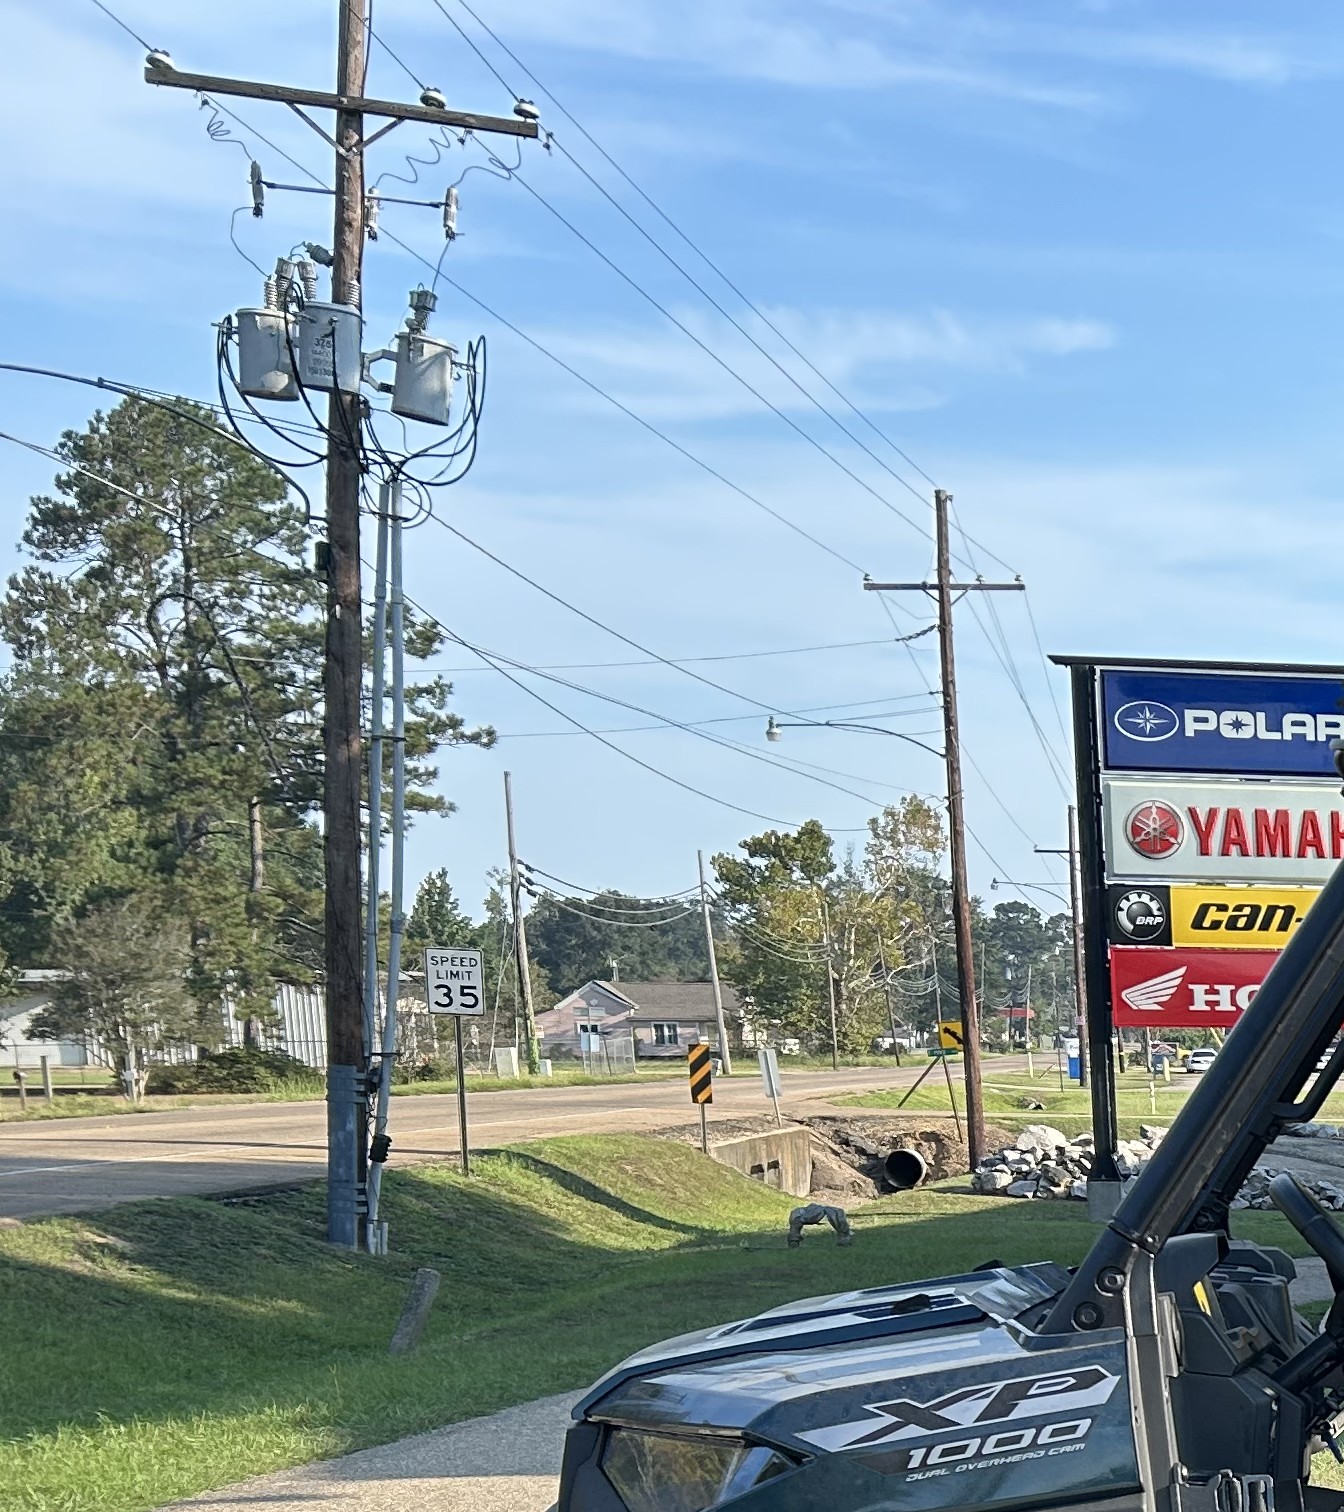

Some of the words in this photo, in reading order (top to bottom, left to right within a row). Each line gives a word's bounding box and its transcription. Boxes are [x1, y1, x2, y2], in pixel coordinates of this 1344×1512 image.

[1136, 916, 1163, 926] BRP
[1190, 903, 1304, 932] can-
[430, 955, 478, 967] SPEED
[436, 969, 472, 980] LIMIT
[434, 984, 479, 1008] 35
[838, 1366, 1108, 1449] XP
[907, 1418, 1092, 1469] 1000
[905, 1468, 950, 1482] DUAL
[955, 1450, 1045, 1473] OVERHEAD
[1047, 1443, 1086, 1456] CAM
